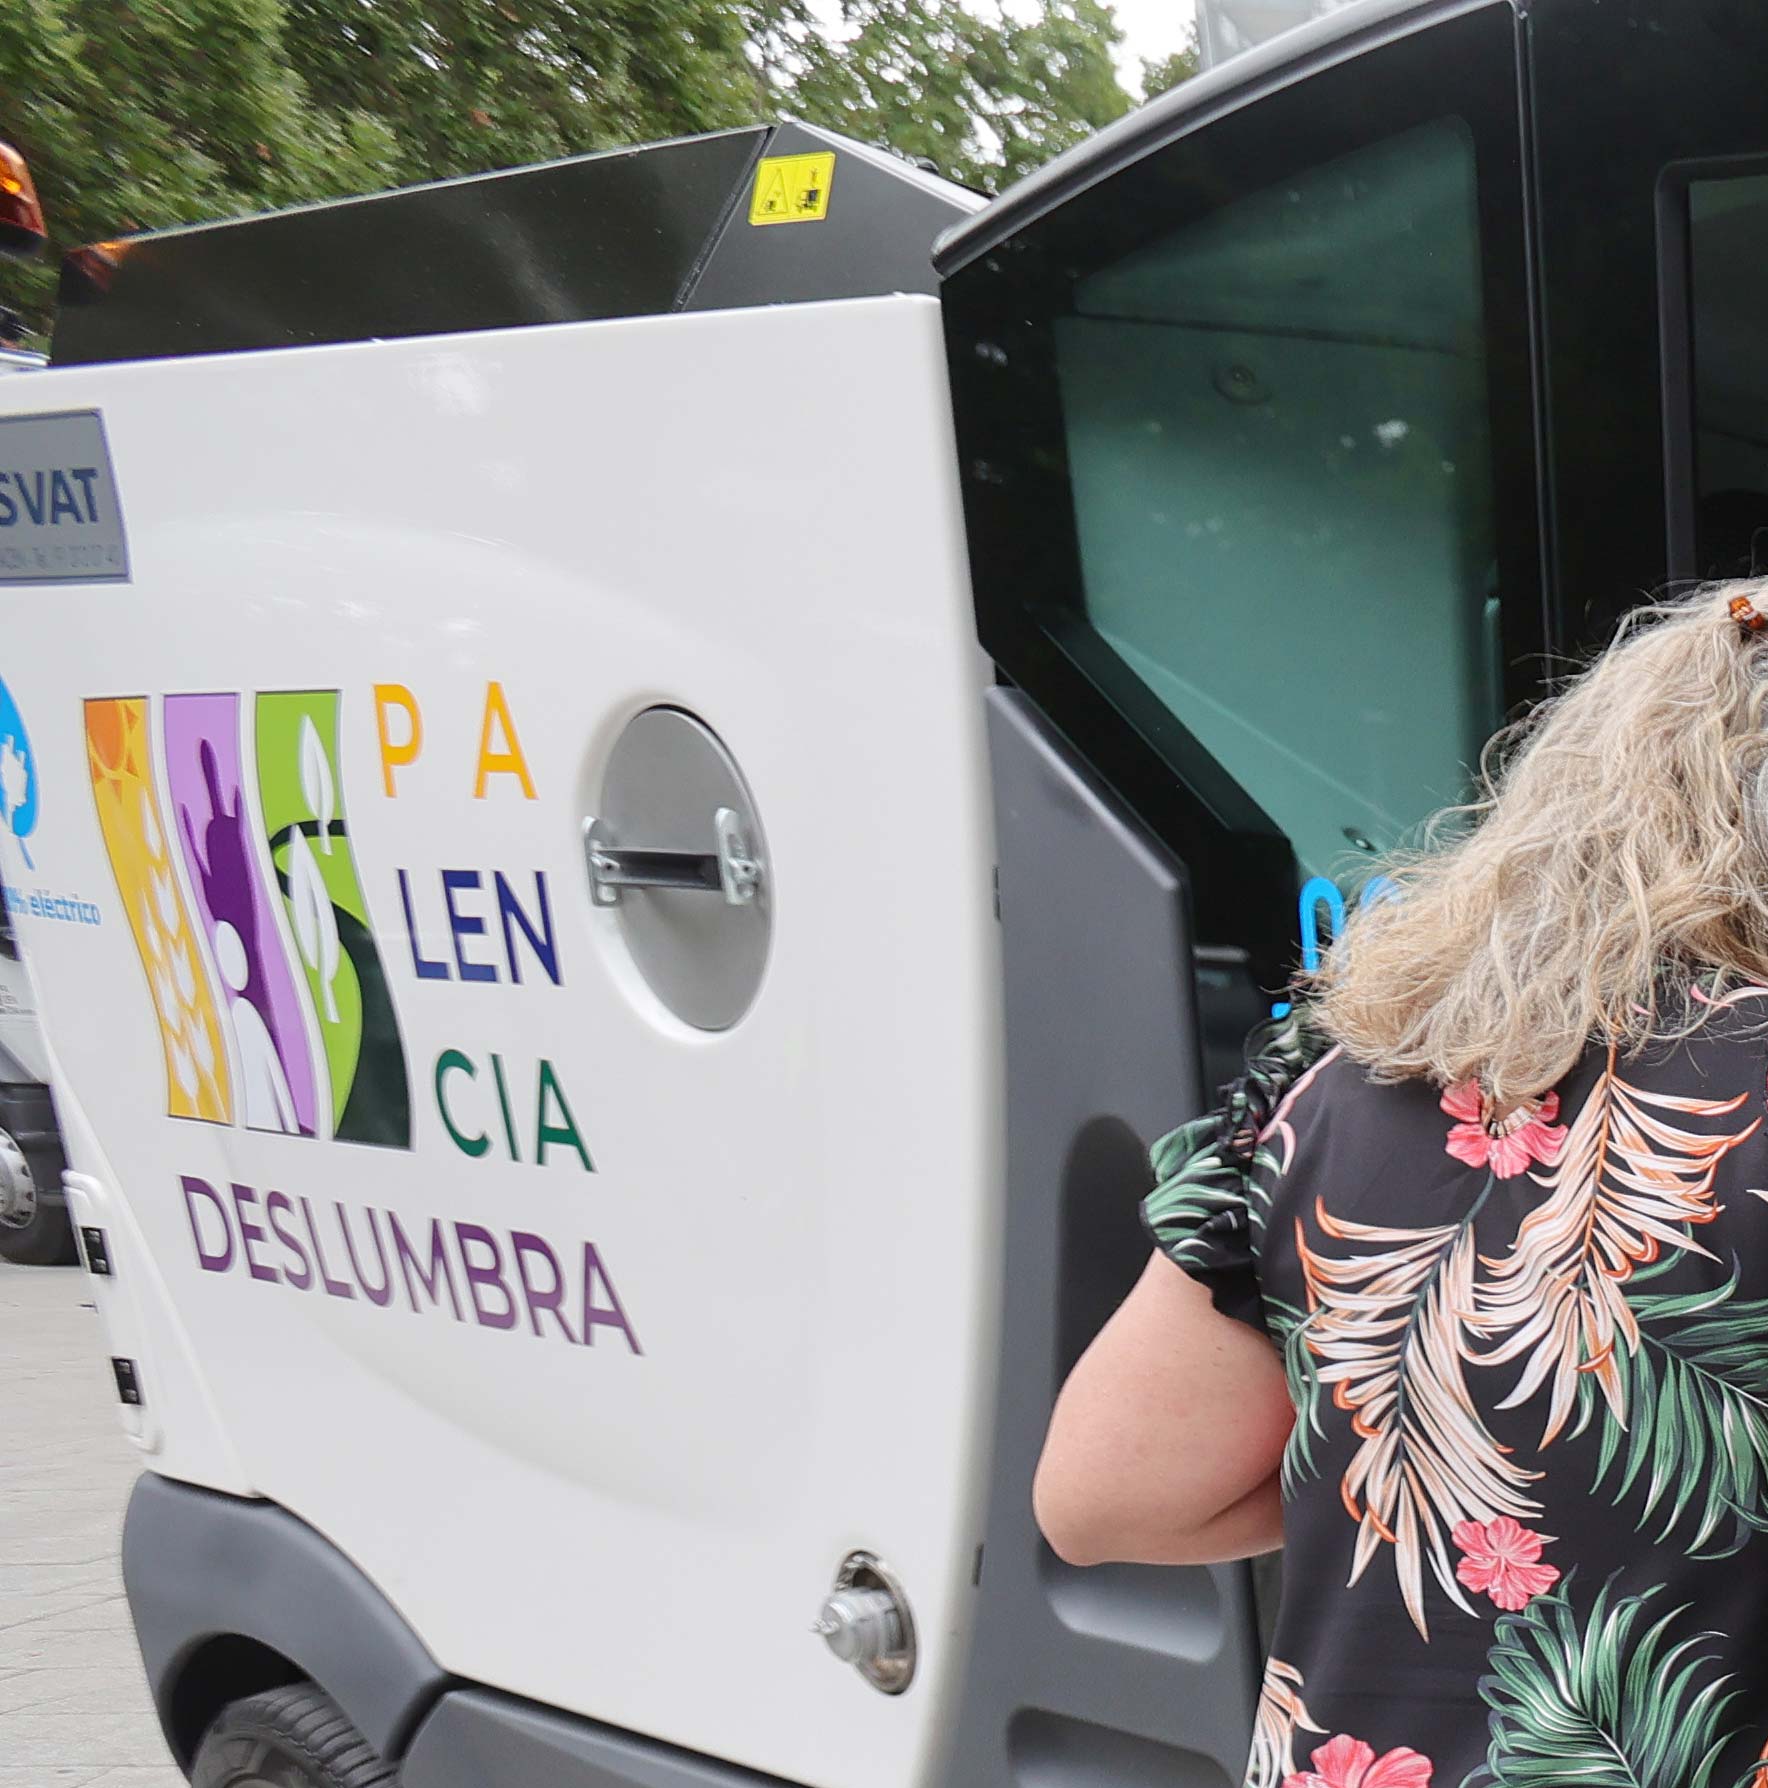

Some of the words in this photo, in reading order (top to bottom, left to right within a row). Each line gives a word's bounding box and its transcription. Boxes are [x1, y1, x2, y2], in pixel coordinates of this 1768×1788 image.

[396, 868, 565, 988] LEN
[432, 1048, 597, 1173] CIA
[180, 1174, 646, 1357] DESLUMBRA
